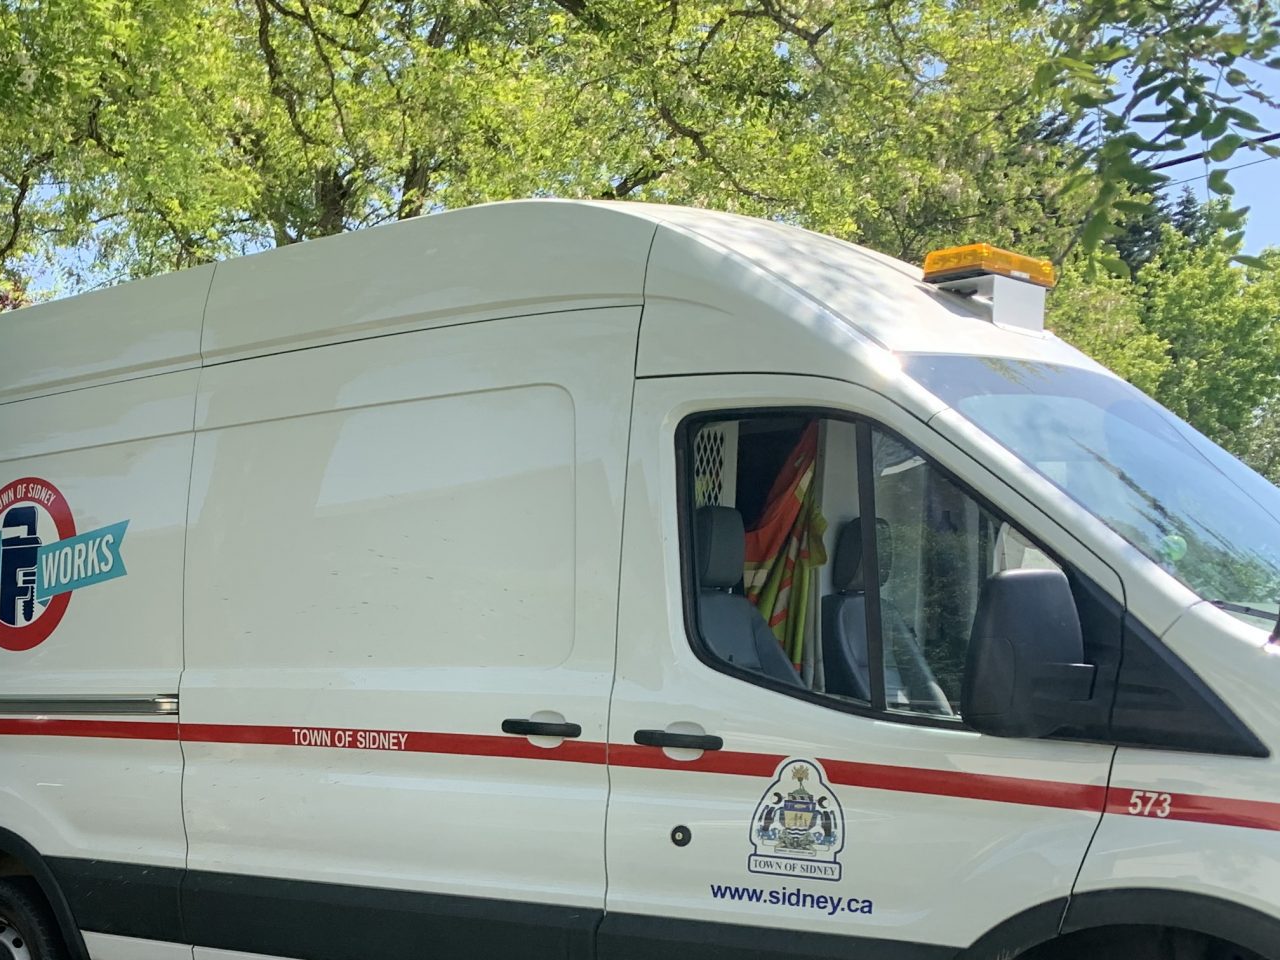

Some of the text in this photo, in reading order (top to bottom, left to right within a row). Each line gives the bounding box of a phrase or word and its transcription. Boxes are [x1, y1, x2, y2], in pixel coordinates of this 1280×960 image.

[16, 483, 27, 499] OF
[27, 483, 56, 507] SIDNEY
[41, 533, 115, 589] WORKS
[292, 728, 408, 750] TOWN OF SIDNEY
[1128, 790, 1171, 817] 573
[753, 858, 837, 876] TOWN OF SIDNEY
[710, 884, 873, 915] www.sidney.ca
